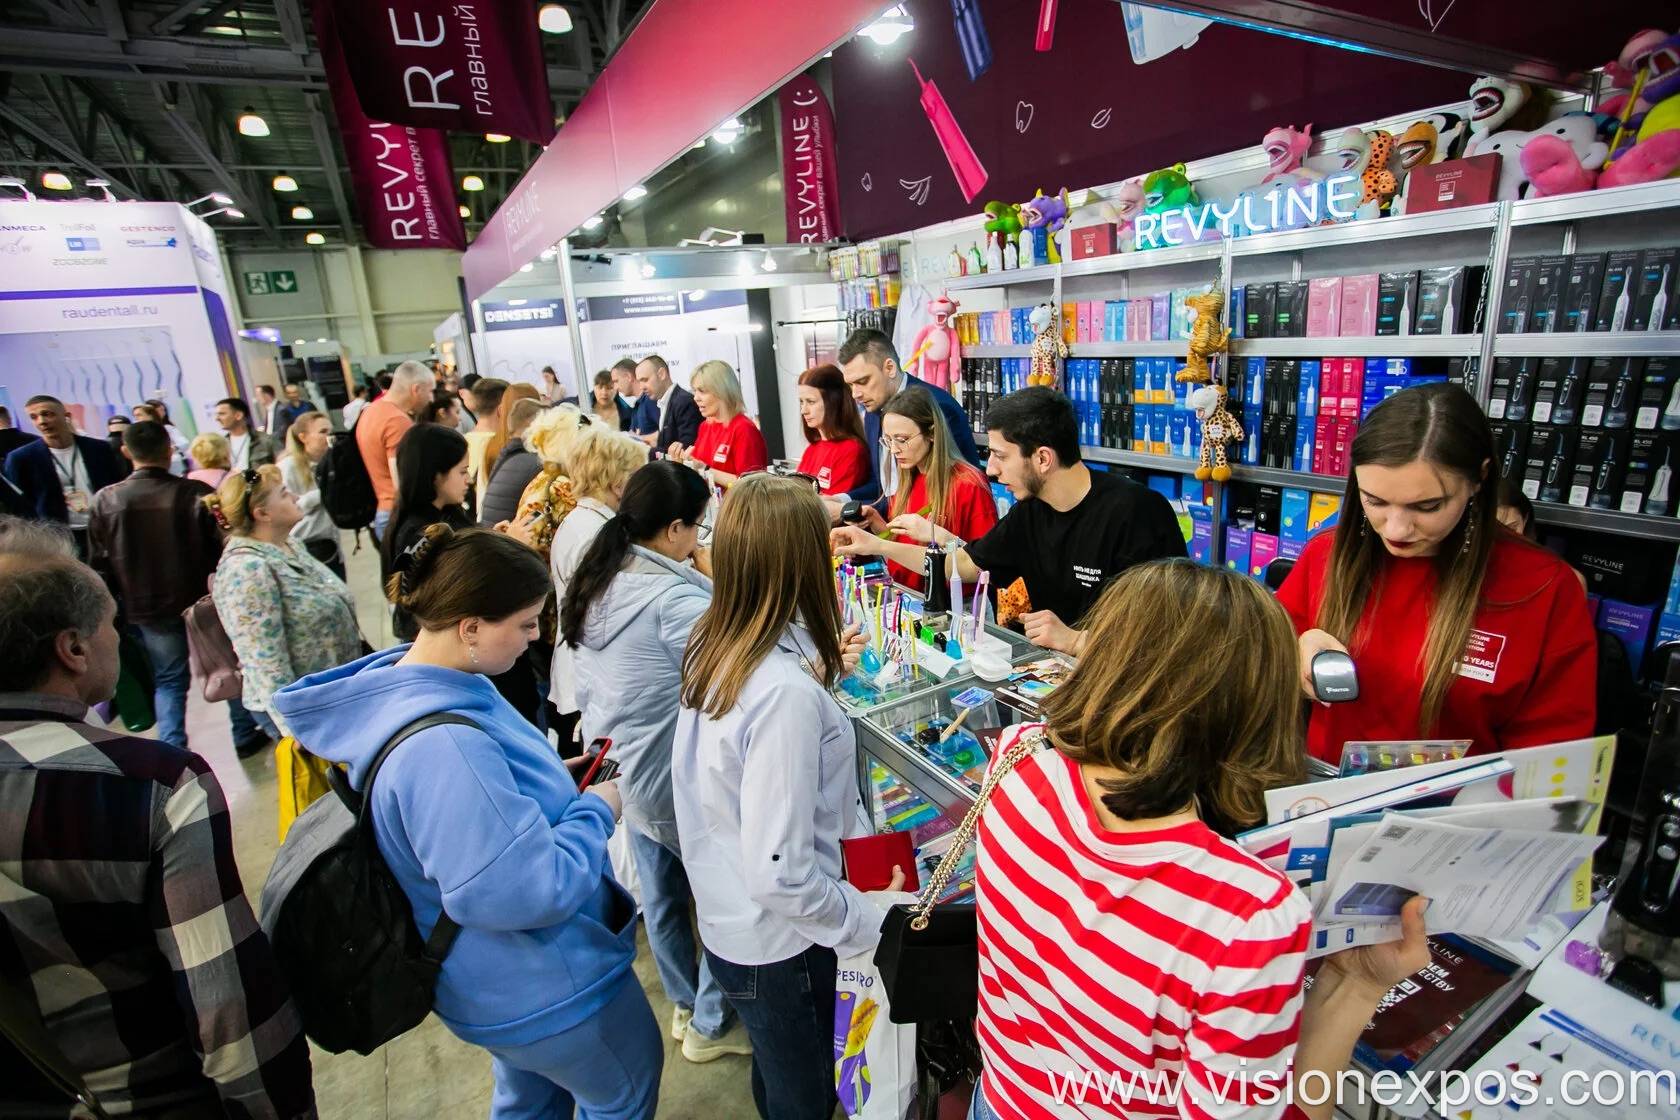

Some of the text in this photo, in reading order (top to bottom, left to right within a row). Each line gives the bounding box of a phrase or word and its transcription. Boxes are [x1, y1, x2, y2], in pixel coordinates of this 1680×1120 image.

[453, 4, 493, 115] главный
[407, 138, 427, 181] секрет
[416, 184, 441, 240] главный
[1134, 175, 1360, 250] REVYLINE
[1582, 554, 1624, 570] REVYLINE
[1470, 657, 1495, 668] YEARS
[1299, 854, 1317, 862] 24
[1418, 969, 1456, 992] ЕСТВУ
